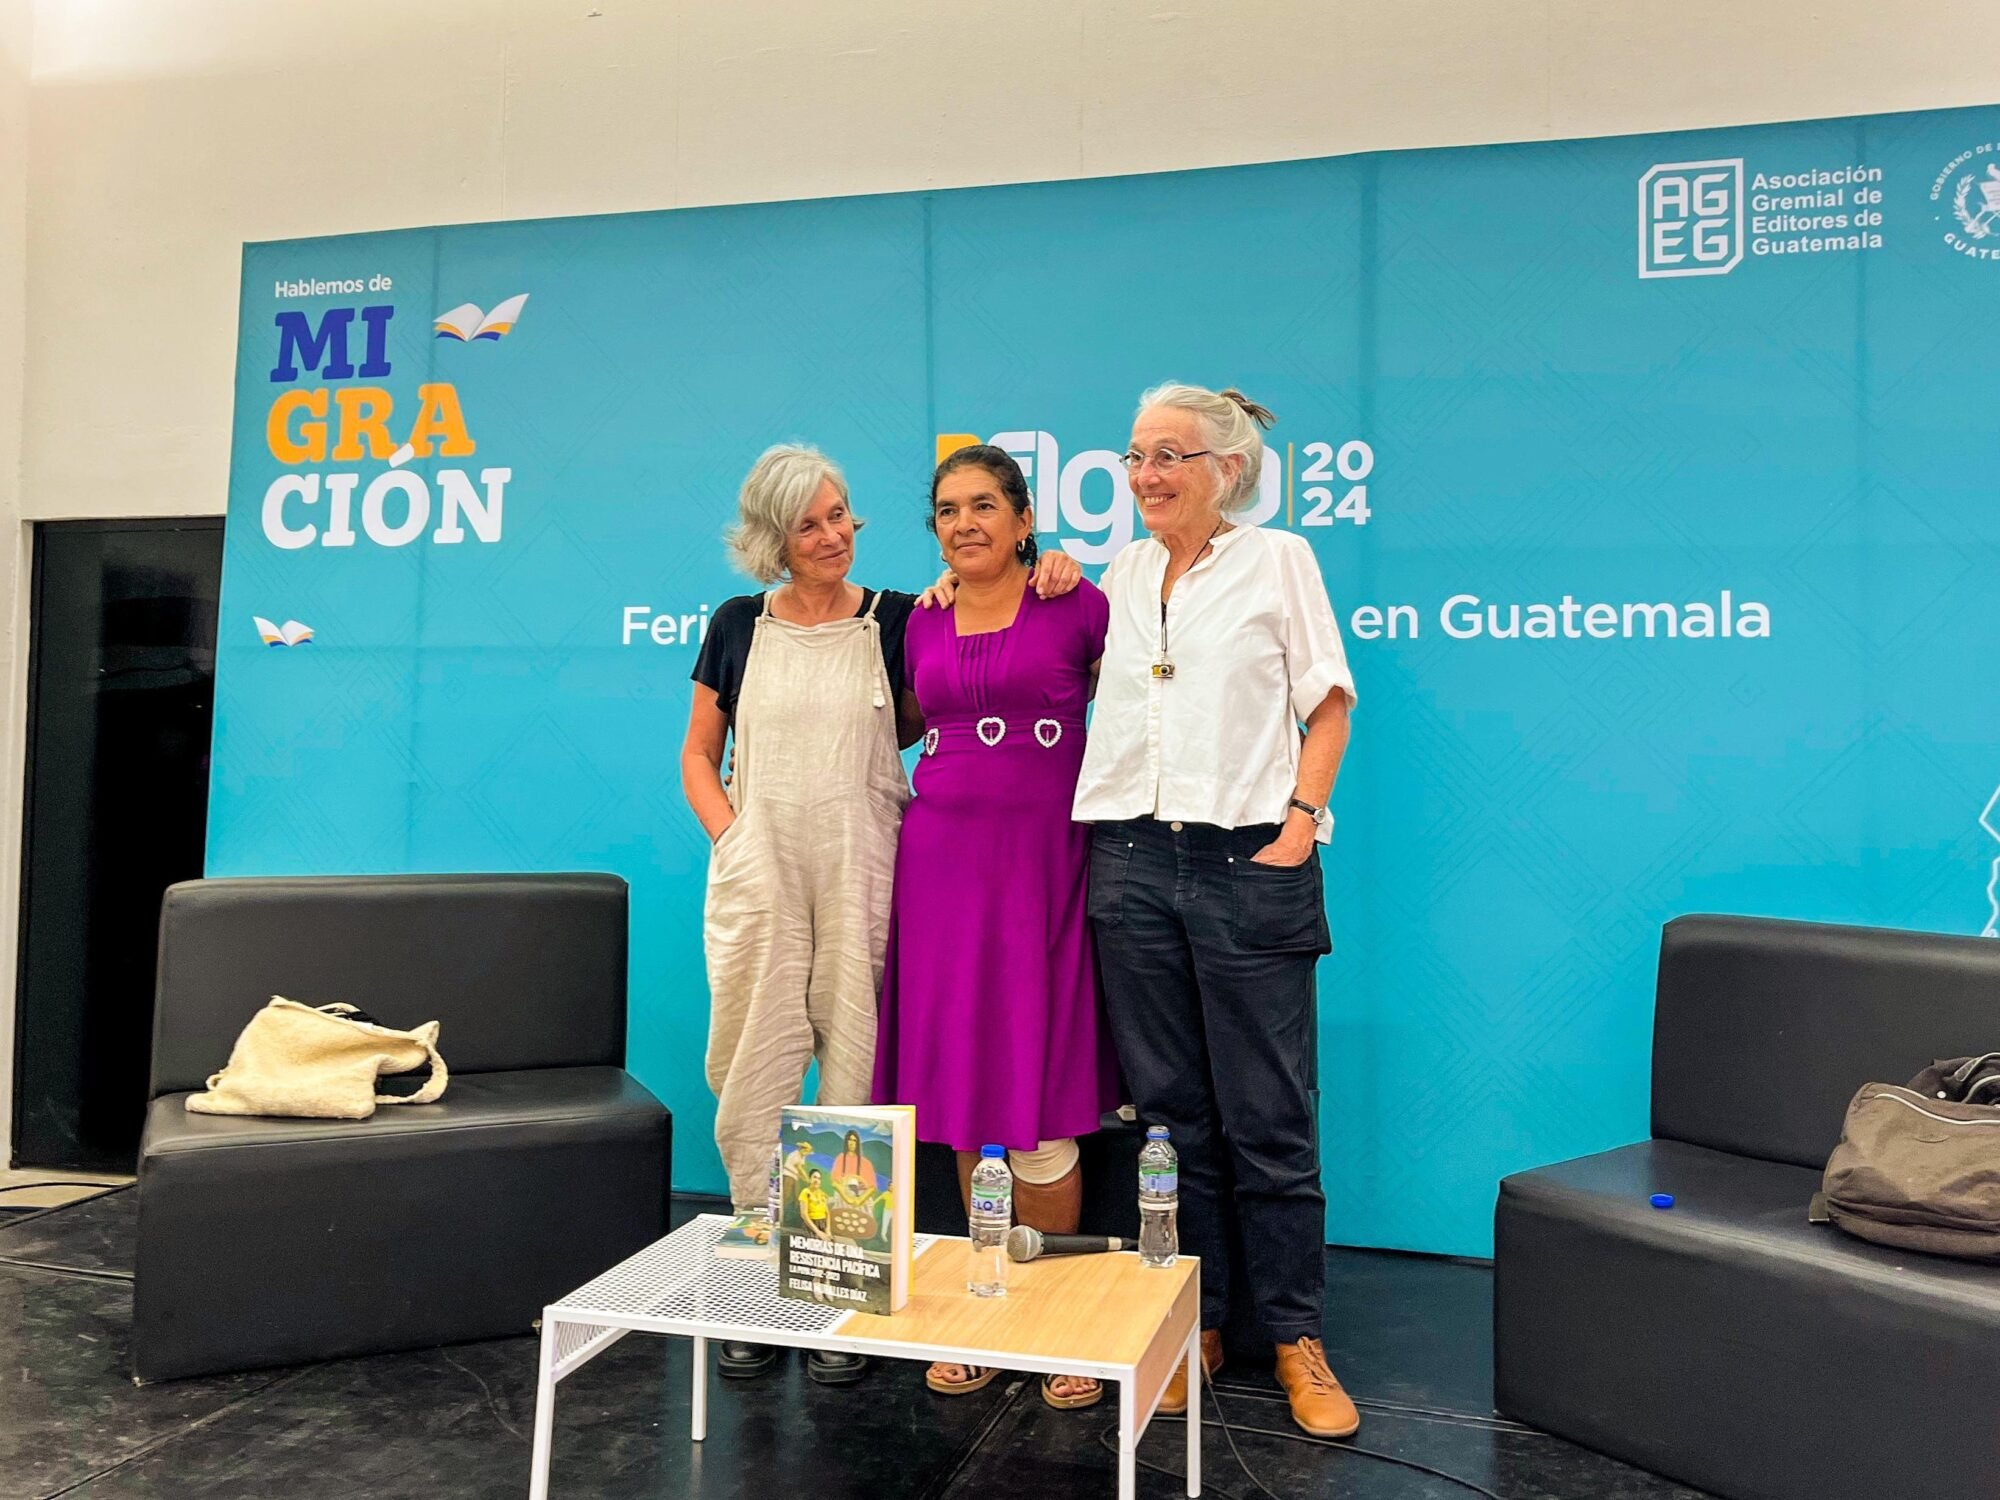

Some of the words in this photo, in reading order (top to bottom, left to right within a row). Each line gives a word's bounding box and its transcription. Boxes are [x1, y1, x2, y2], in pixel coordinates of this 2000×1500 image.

[1751, 165, 1882, 191] Asociación
[1930, 150, 1973, 201] GOBIERNO
[1975, 143, 1992, 154] DE
[1751, 189, 1843, 212] Gremial
[1853, 188, 1883, 205] de
[1752, 213, 1848, 234] Editores
[1854, 209, 1883, 227] de
[1751, 231, 1883, 256] Guatemala
[275, 277, 364, 298] Hablemos
[368, 274, 393, 292] de
[270, 305, 394, 382] MI
[266, 383, 475, 464] GRA
[1301, 440, 1374, 482] 20
[261, 443, 512, 549] CIÓN
[1301, 485, 1371, 527] 24
[1351, 604, 1419, 639] en
[1440, 590, 1771, 639] Guatemala
[790, 1250, 841, 1272] RESISTENCIA
[842, 1260, 880, 1278] PACÍFICA
